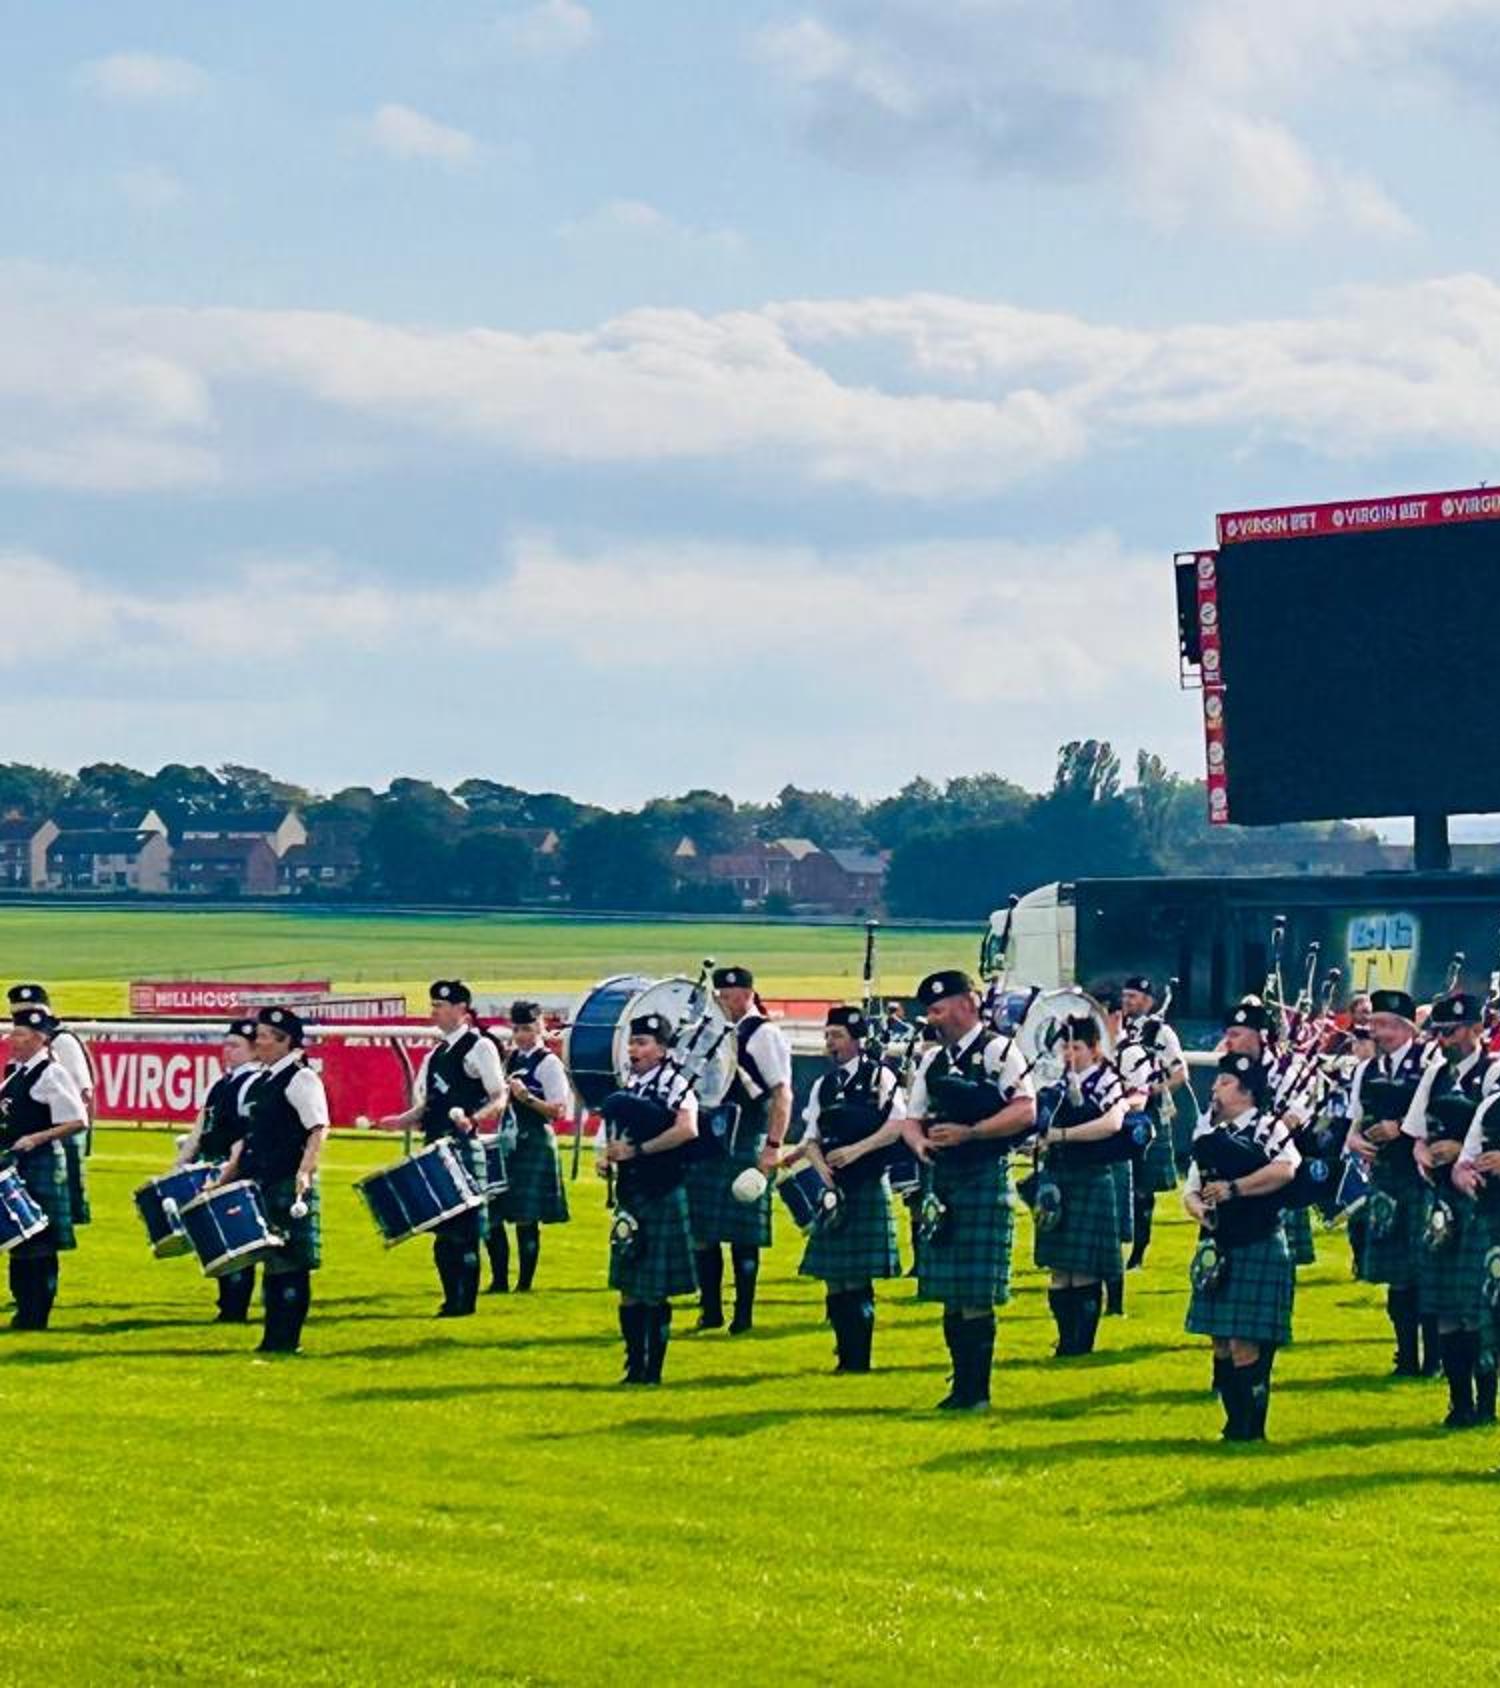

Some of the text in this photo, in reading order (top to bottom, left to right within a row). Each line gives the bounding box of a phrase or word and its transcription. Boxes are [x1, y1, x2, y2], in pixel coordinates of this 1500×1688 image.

[1239, 516, 1287, 536] VIRGIN
[1345, 503, 1397, 525] VIRGIN
[1399, 500, 1429, 521] BET
[1350, 911, 1415, 950] BIG
[1349, 949, 1411, 993] TV
